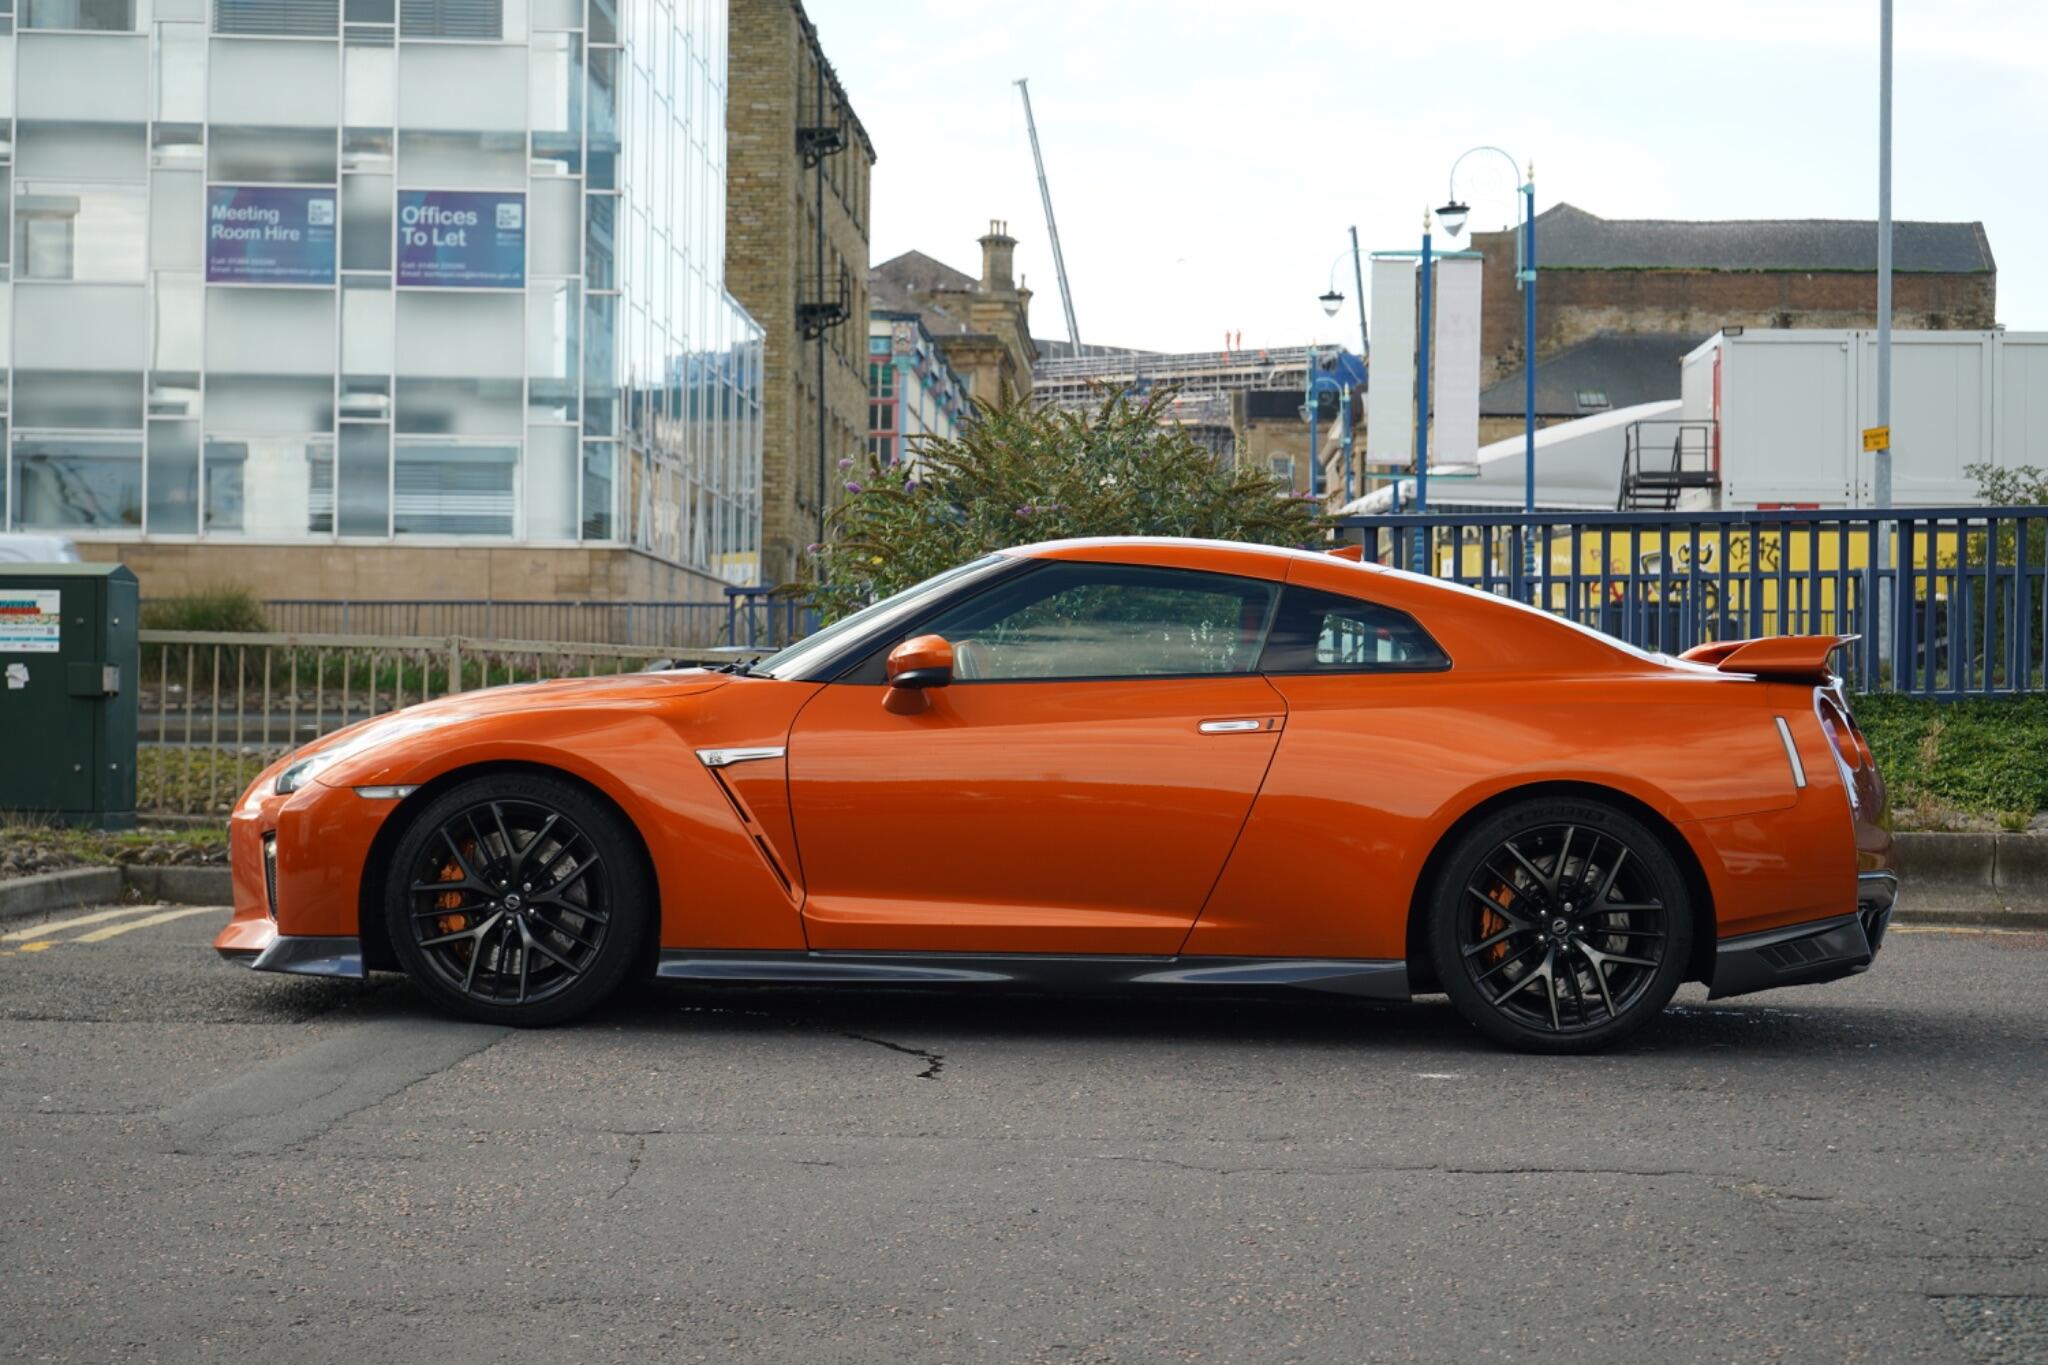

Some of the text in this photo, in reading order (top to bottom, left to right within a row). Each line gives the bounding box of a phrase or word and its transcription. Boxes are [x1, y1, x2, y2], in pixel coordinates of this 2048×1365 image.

[211, 205, 280, 223] Meeting
[401, 205, 478, 225] Offices
[211, 224, 260, 240] Room
[264, 225, 301, 241] Hire
[401, 227, 467, 247] To Let
